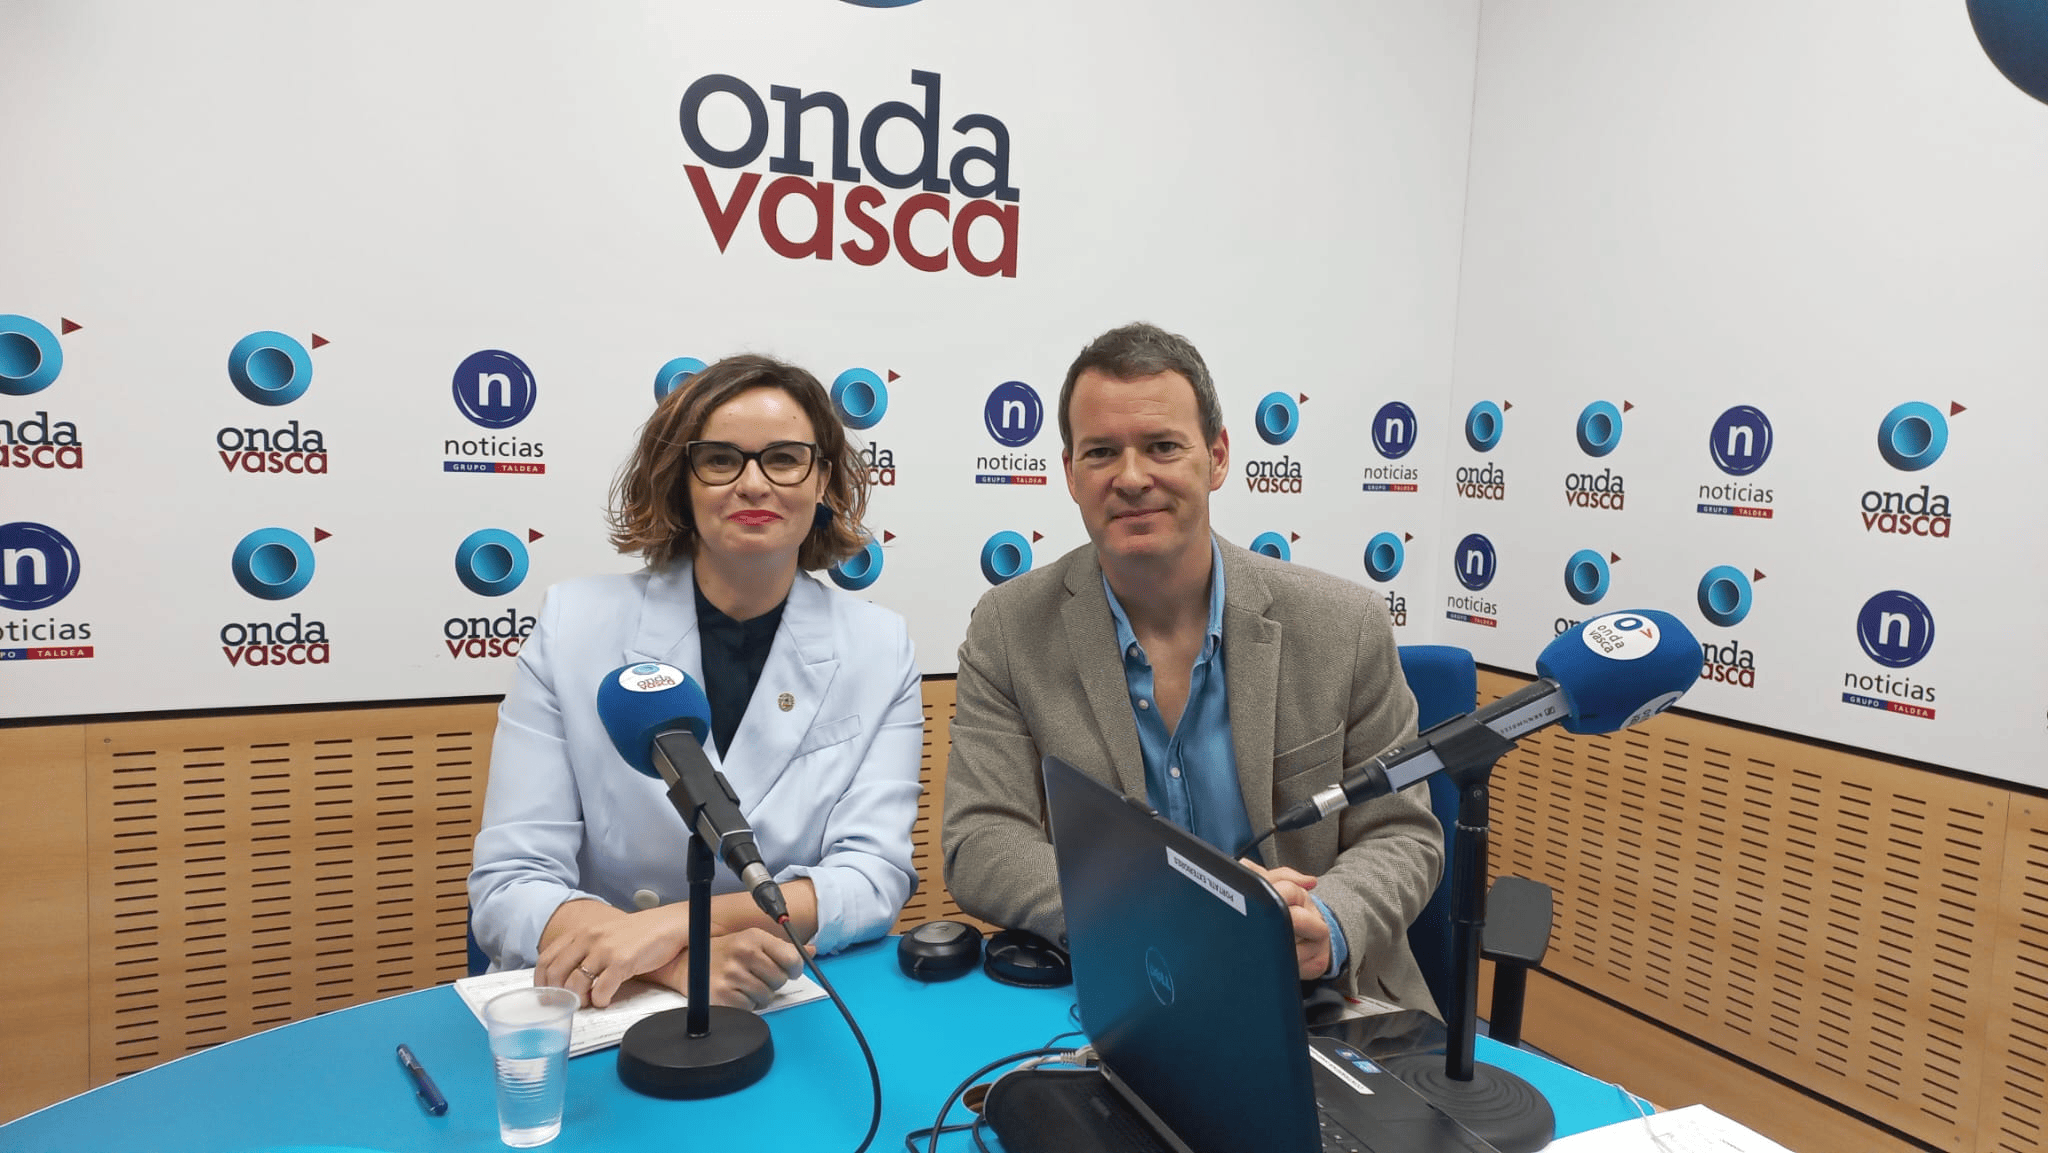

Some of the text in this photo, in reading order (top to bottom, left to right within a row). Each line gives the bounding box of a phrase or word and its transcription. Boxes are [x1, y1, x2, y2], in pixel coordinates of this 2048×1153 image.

[680, 69, 1020, 202] onda
[683, 164, 1019, 278] vasca
[478, 372, 511, 407] n
[1003, 400, 1026, 429] n
[0, 411, 82, 446] nda
[217, 421, 327, 453] onda
[1385, 418, 1404, 444] n
[1727, 425, 1753, 457] n
[0, 444, 83, 469] sca
[445, 436, 544, 457] noticias
[859, 441, 895, 468] da
[219, 451, 328, 474] vasca
[977, 452, 1047, 471] noticias
[1246, 456, 1302, 478] onda
[1364, 464, 1418, 480] noticias
[1456, 462, 1504, 485] onda
[1247, 477, 1302, 494] vasca
[1457, 481, 1504, 500] vasca
[1565, 468, 1624, 493] onda
[1699, 482, 1774, 503] noticias
[1566, 489, 1624, 510] vasca
[1861, 485, 1951, 517] onda
[1862, 511, 1951, 538] vasca
[4, 548, 47, 585] n
[1466, 550, 1483, 576] n
[1447, 595, 1497, 615] noticias
[0, 617, 91, 641] ticias
[221, 613, 329, 645] onda
[1589, 630, 1614, 653] vasca
[1597, 625, 1625, 649] onda
[1878, 611, 1910, 648] n
[37, 649, 85, 657] TALDEA
[222, 642, 330, 667] vasca
[445, 637, 526, 660] vasc
[1702, 640, 1755, 670] nda
[1700, 661, 1755, 688] asca
[1845, 672, 1936, 702] noticias
[1850, 696, 1929, 717] GRUPO TALDEA
